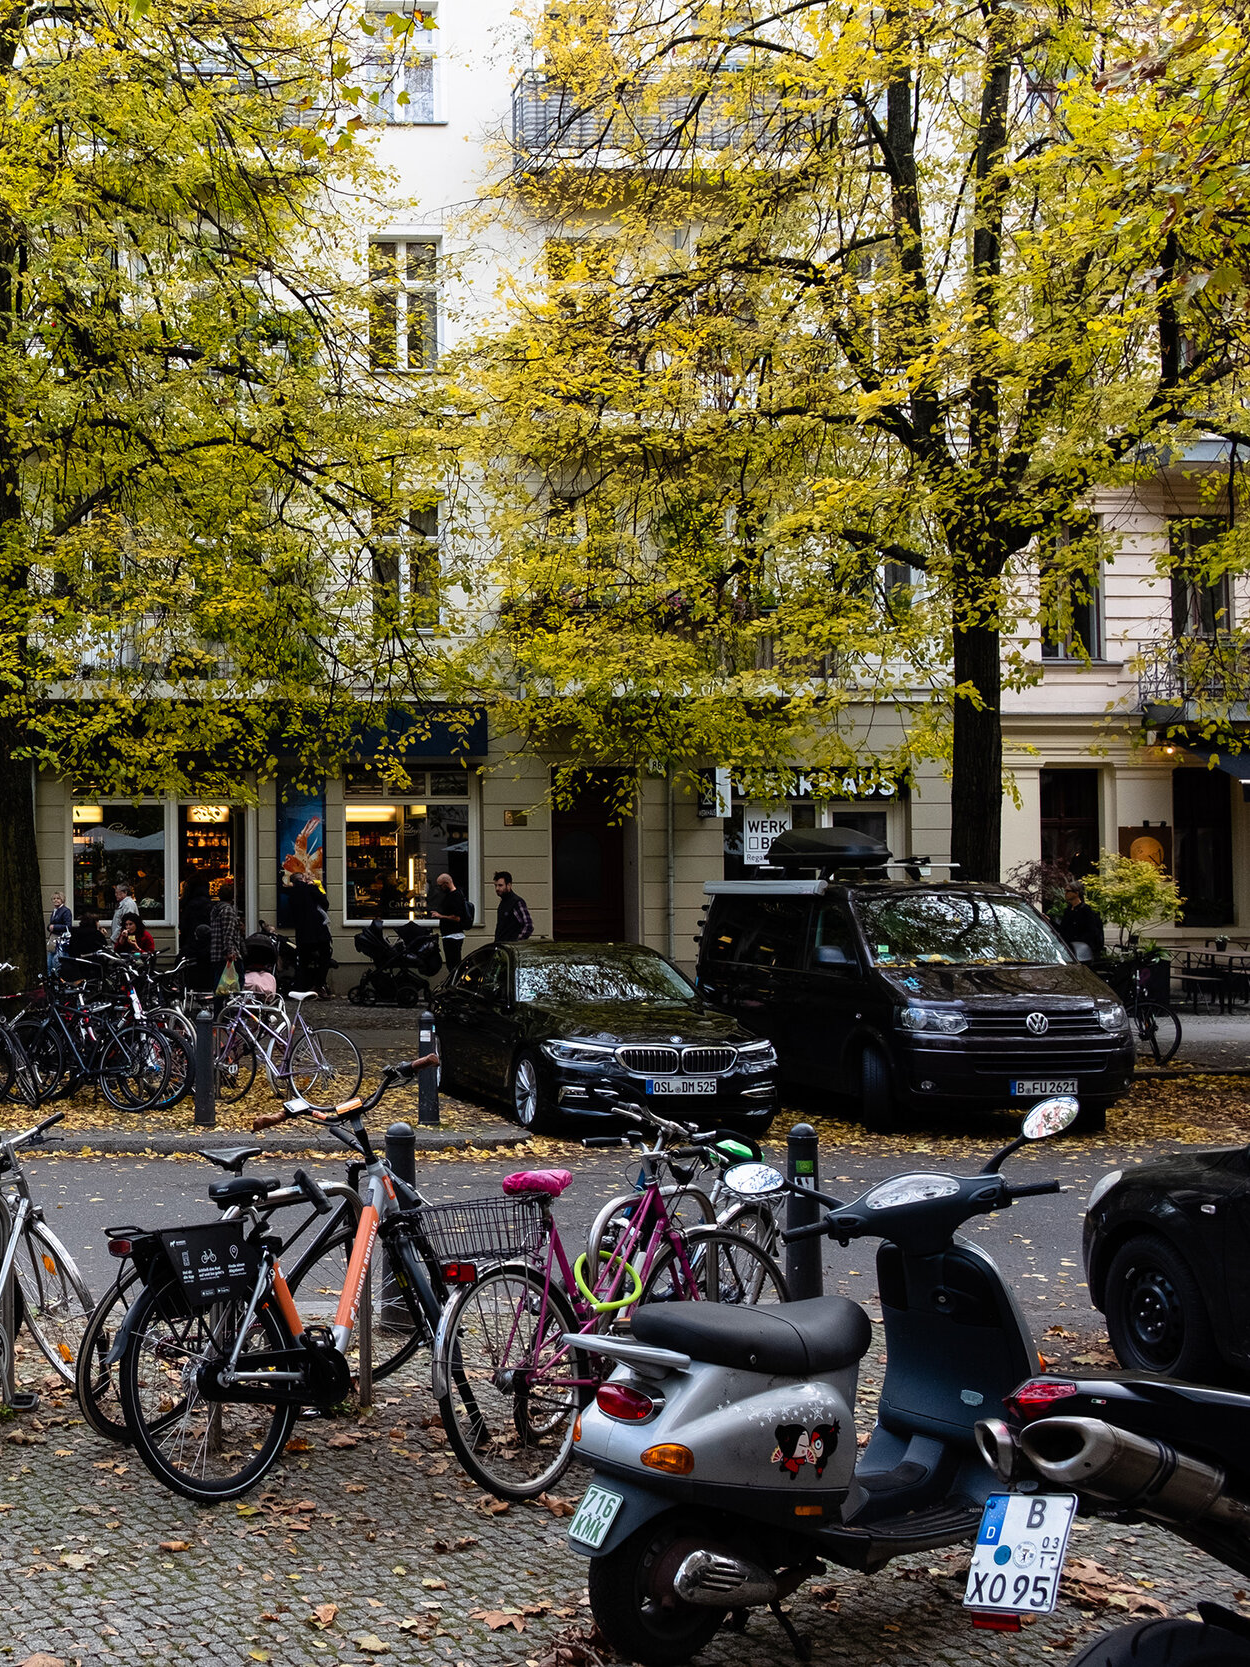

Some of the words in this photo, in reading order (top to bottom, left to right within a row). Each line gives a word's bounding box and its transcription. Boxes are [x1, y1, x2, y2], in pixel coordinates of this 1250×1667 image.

[748, 820, 787, 833] WERK
[747, 854, 765, 863] Rega
[654, 1081, 673, 1093] OSL
[682, 1081, 695, 1093] DM
[697, 1081, 716, 1093] 525
[1017, 1082, 1025, 1093] B
[1032, 1082, 1047, 1093] FU
[1049, 1082, 1076, 1093] 2621
[354, 1265, 367, 1307] DONKEY
[364, 1220, 378, 1265] REPUBLIC
[583, 1490, 616, 1518] 716
[1026, 1499, 1047, 1528] B
[573, 1514, 605, 1543] KMK
[986, 1526, 996, 1539] D
[1042, 1537, 1060, 1549] 03
[1040, 1556, 1057, 1568] 1
[1013, 1575, 1050, 1607] 95
